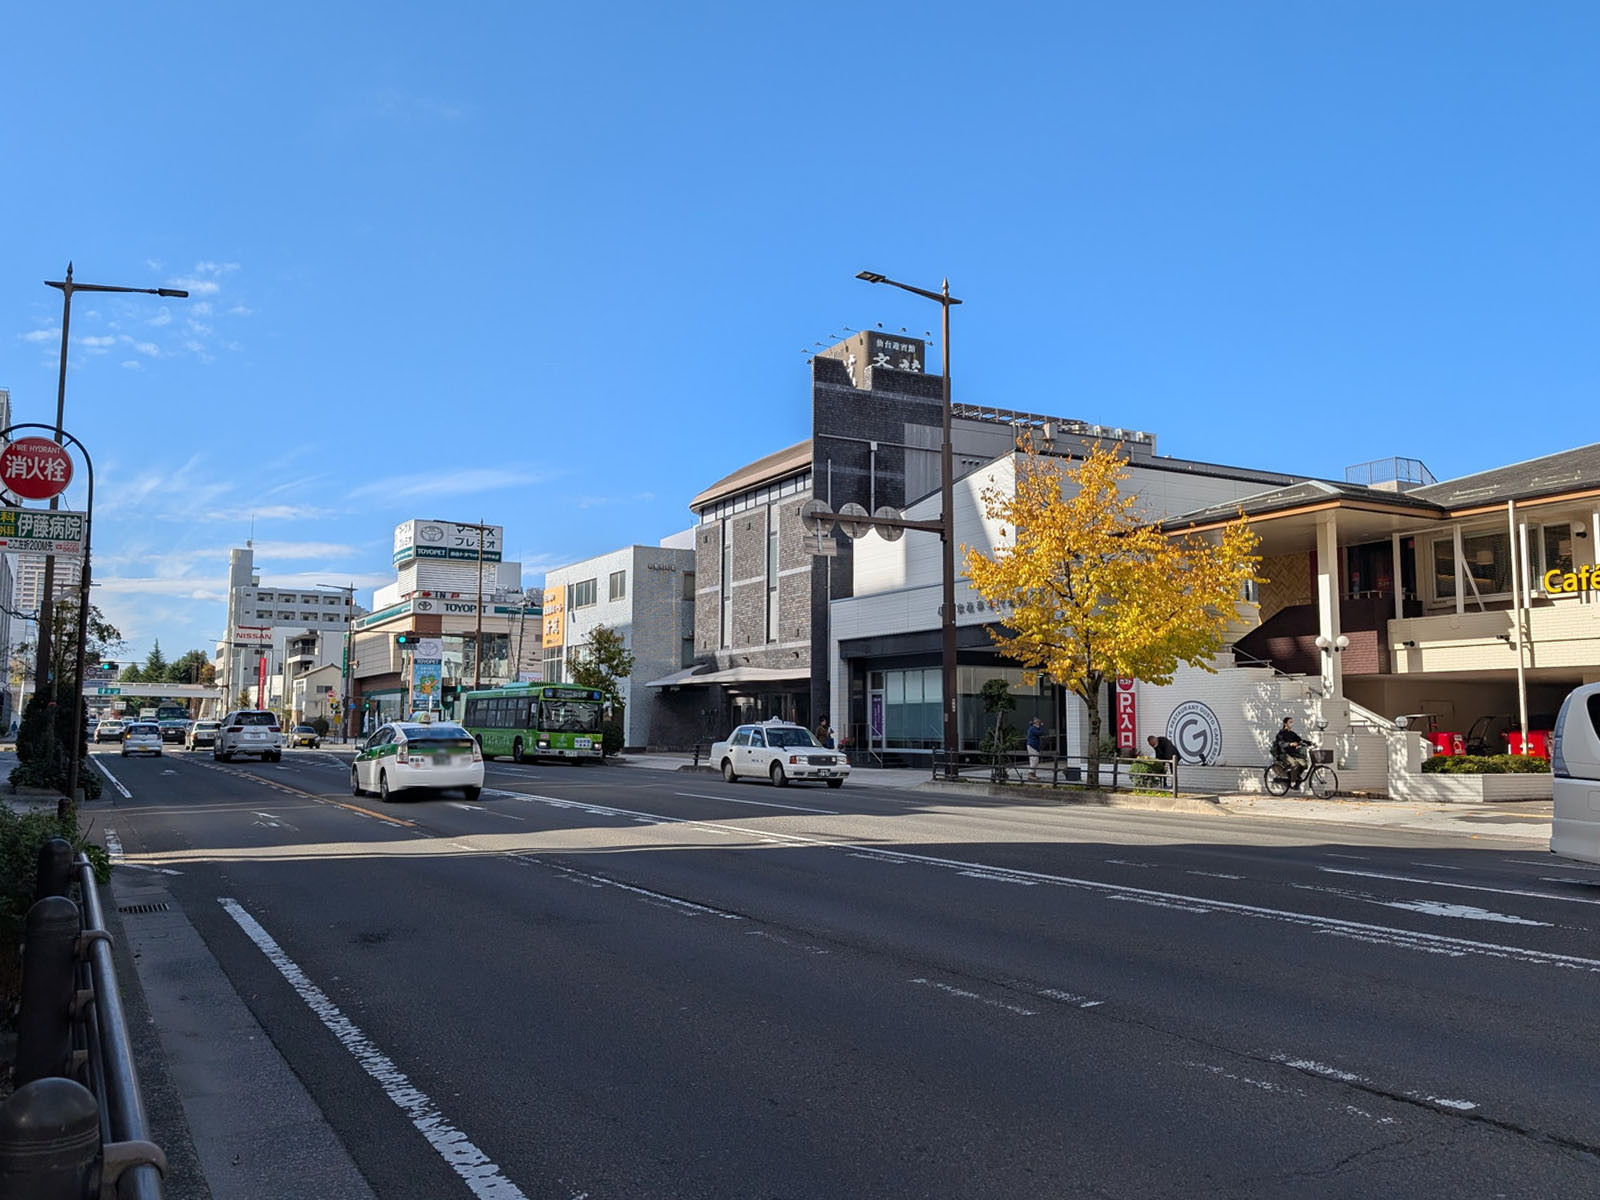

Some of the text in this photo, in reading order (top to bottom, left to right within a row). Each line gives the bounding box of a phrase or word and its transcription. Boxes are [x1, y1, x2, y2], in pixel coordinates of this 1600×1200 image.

[12, 444, 61, 454] FIRE HYDRANT
[5, 454, 67, 482] 消火栓
[17, 512, 81, 540] 伊藤病院
[417, 548, 445, 556] TOYOPET
[1544, 564, 1600, 593] Café
[445, 603, 487, 613] TOYOPT
[236, 632, 272, 640] NISSAN
[1170, 704, 1199, 729] RESTAURANT
[1200, 706, 1216, 726] GUSTO
[1179, 719, 1208, 757] G
